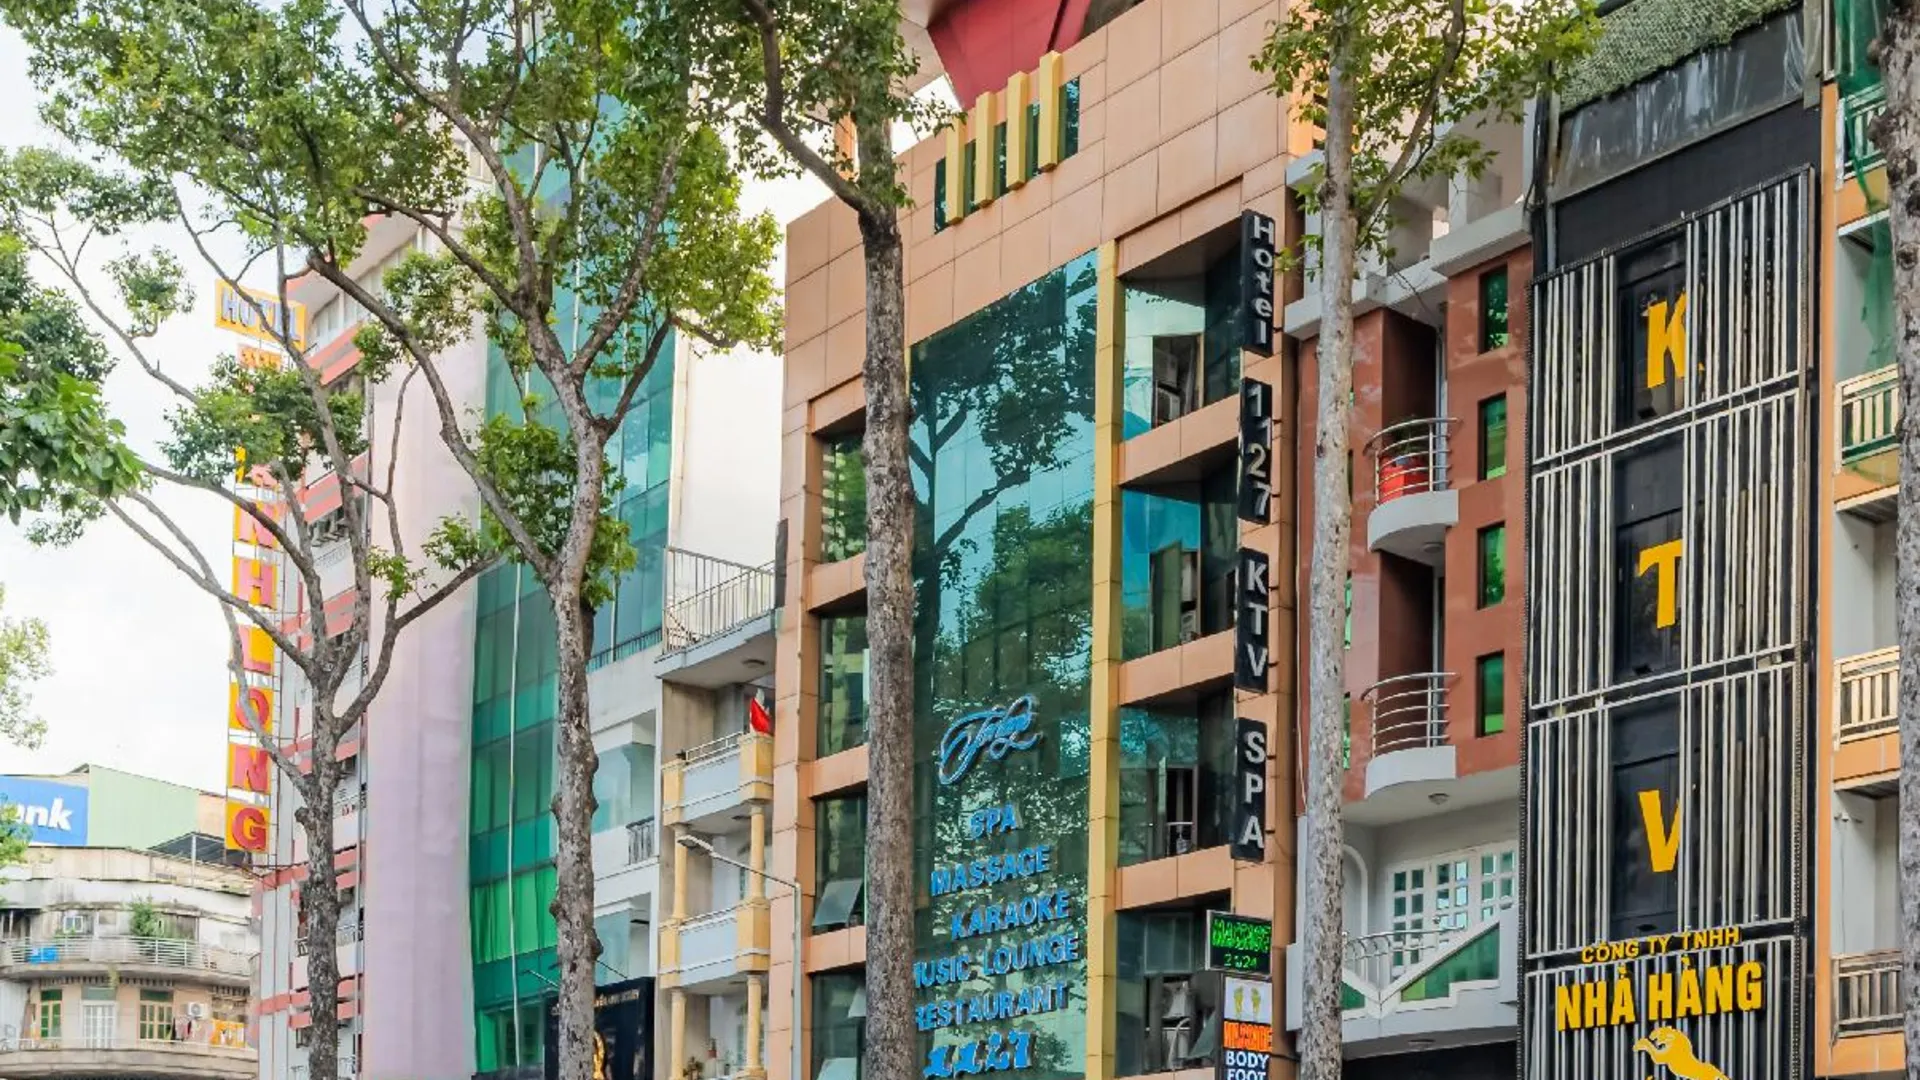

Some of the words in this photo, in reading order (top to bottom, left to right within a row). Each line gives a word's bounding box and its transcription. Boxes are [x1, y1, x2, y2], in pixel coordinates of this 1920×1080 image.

[1252, 214, 1275, 344] Hotel
[1246, 384, 1273, 516] 1127
[1637, 290, 1689, 873] KTV
[1246, 559, 1269, 677] KTV
[1240, 730, 1267, 849] SPA
[970, 802, 1018, 840] SPA
[930, 844, 1052, 897] MASSAGE
[951, 889, 1071, 940] KARAOKE
[983, 930, 1079, 977] LOUNGE
[1581, 940, 1640, 963] CÔNG
[1646, 934, 1671, 956] TY
[1682, 926, 1741, 950] TNHH
[1556, 963, 1636, 1032] NHÀ
[1648, 954, 1763, 1021] HÀNG
[1225, 1050, 1269, 1069] BODY
[1226, 1068, 1267, 1080] FOOT
